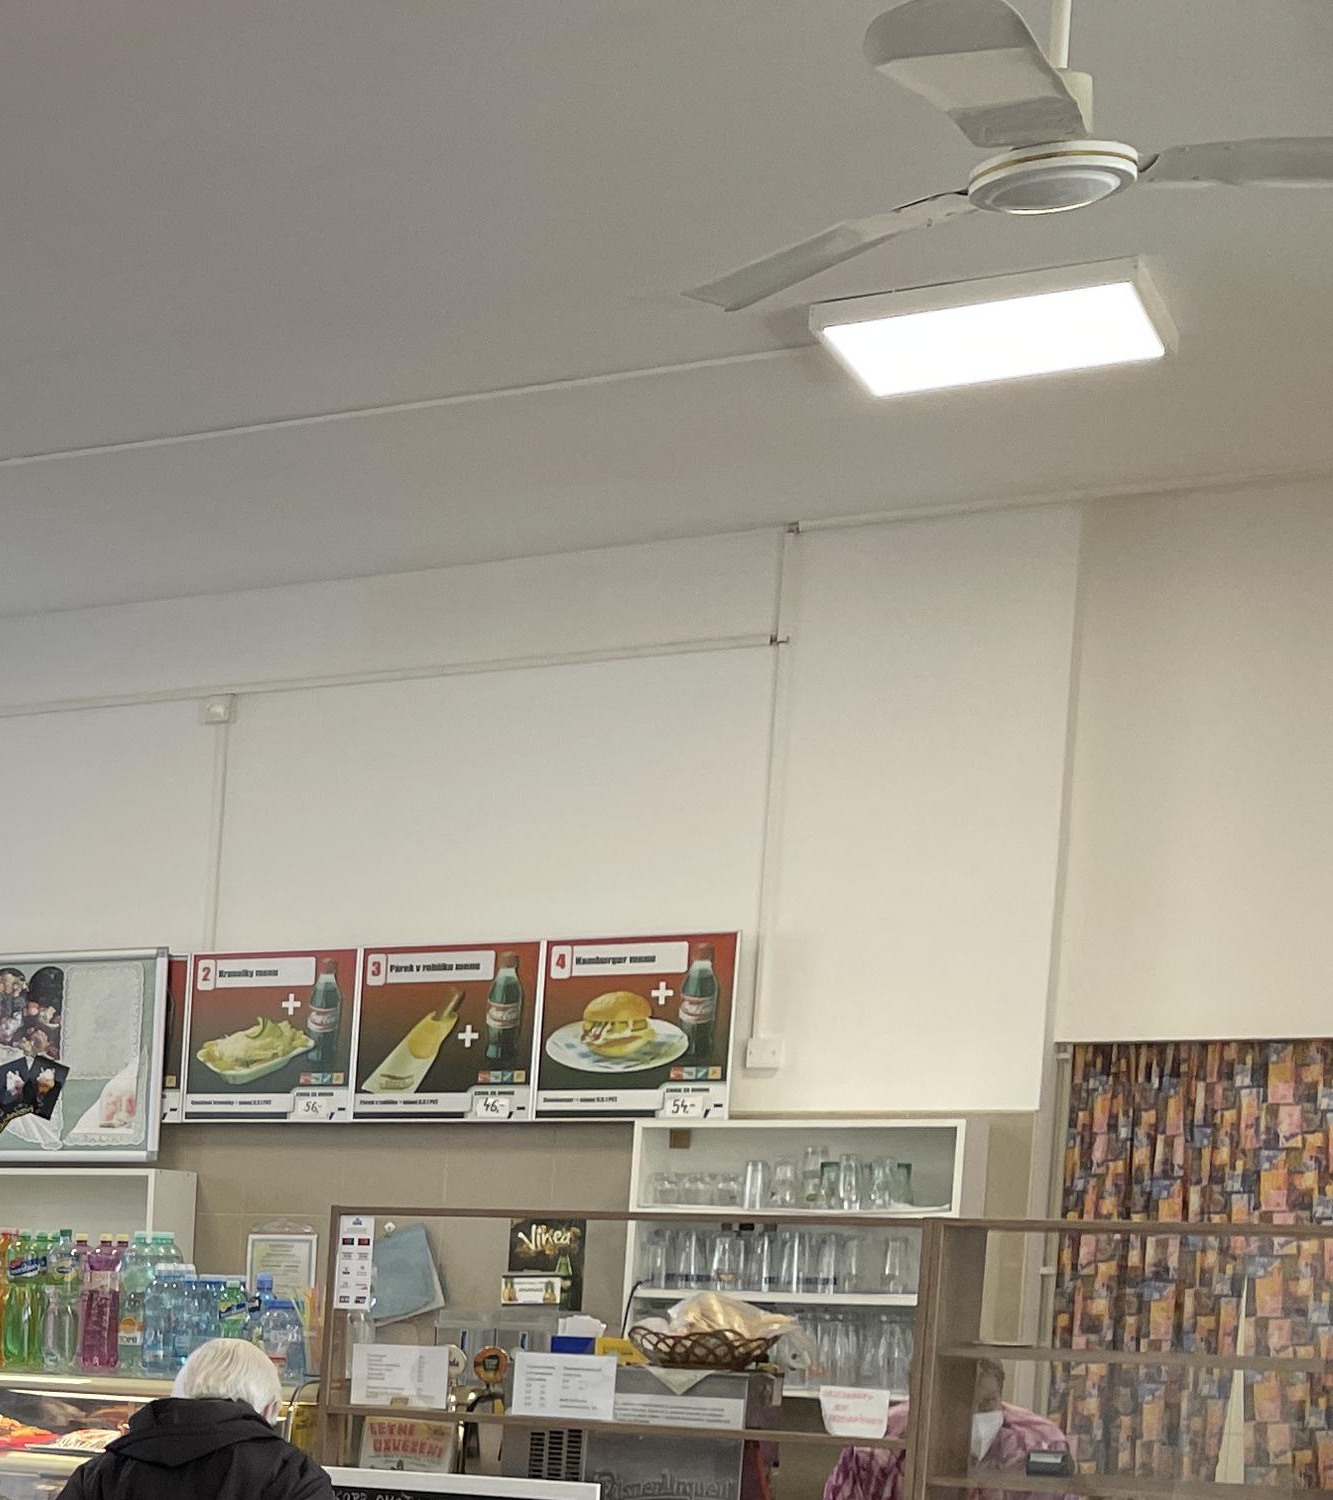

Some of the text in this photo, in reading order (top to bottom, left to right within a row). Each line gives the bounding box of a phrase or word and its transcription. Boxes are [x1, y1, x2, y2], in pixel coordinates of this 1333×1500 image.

[371, 961, 381, 977] 3
[555, 953, 566, 969] 4
[202, 966, 211, 982] 2
[517, 1223, 573, 1252] Vinea
